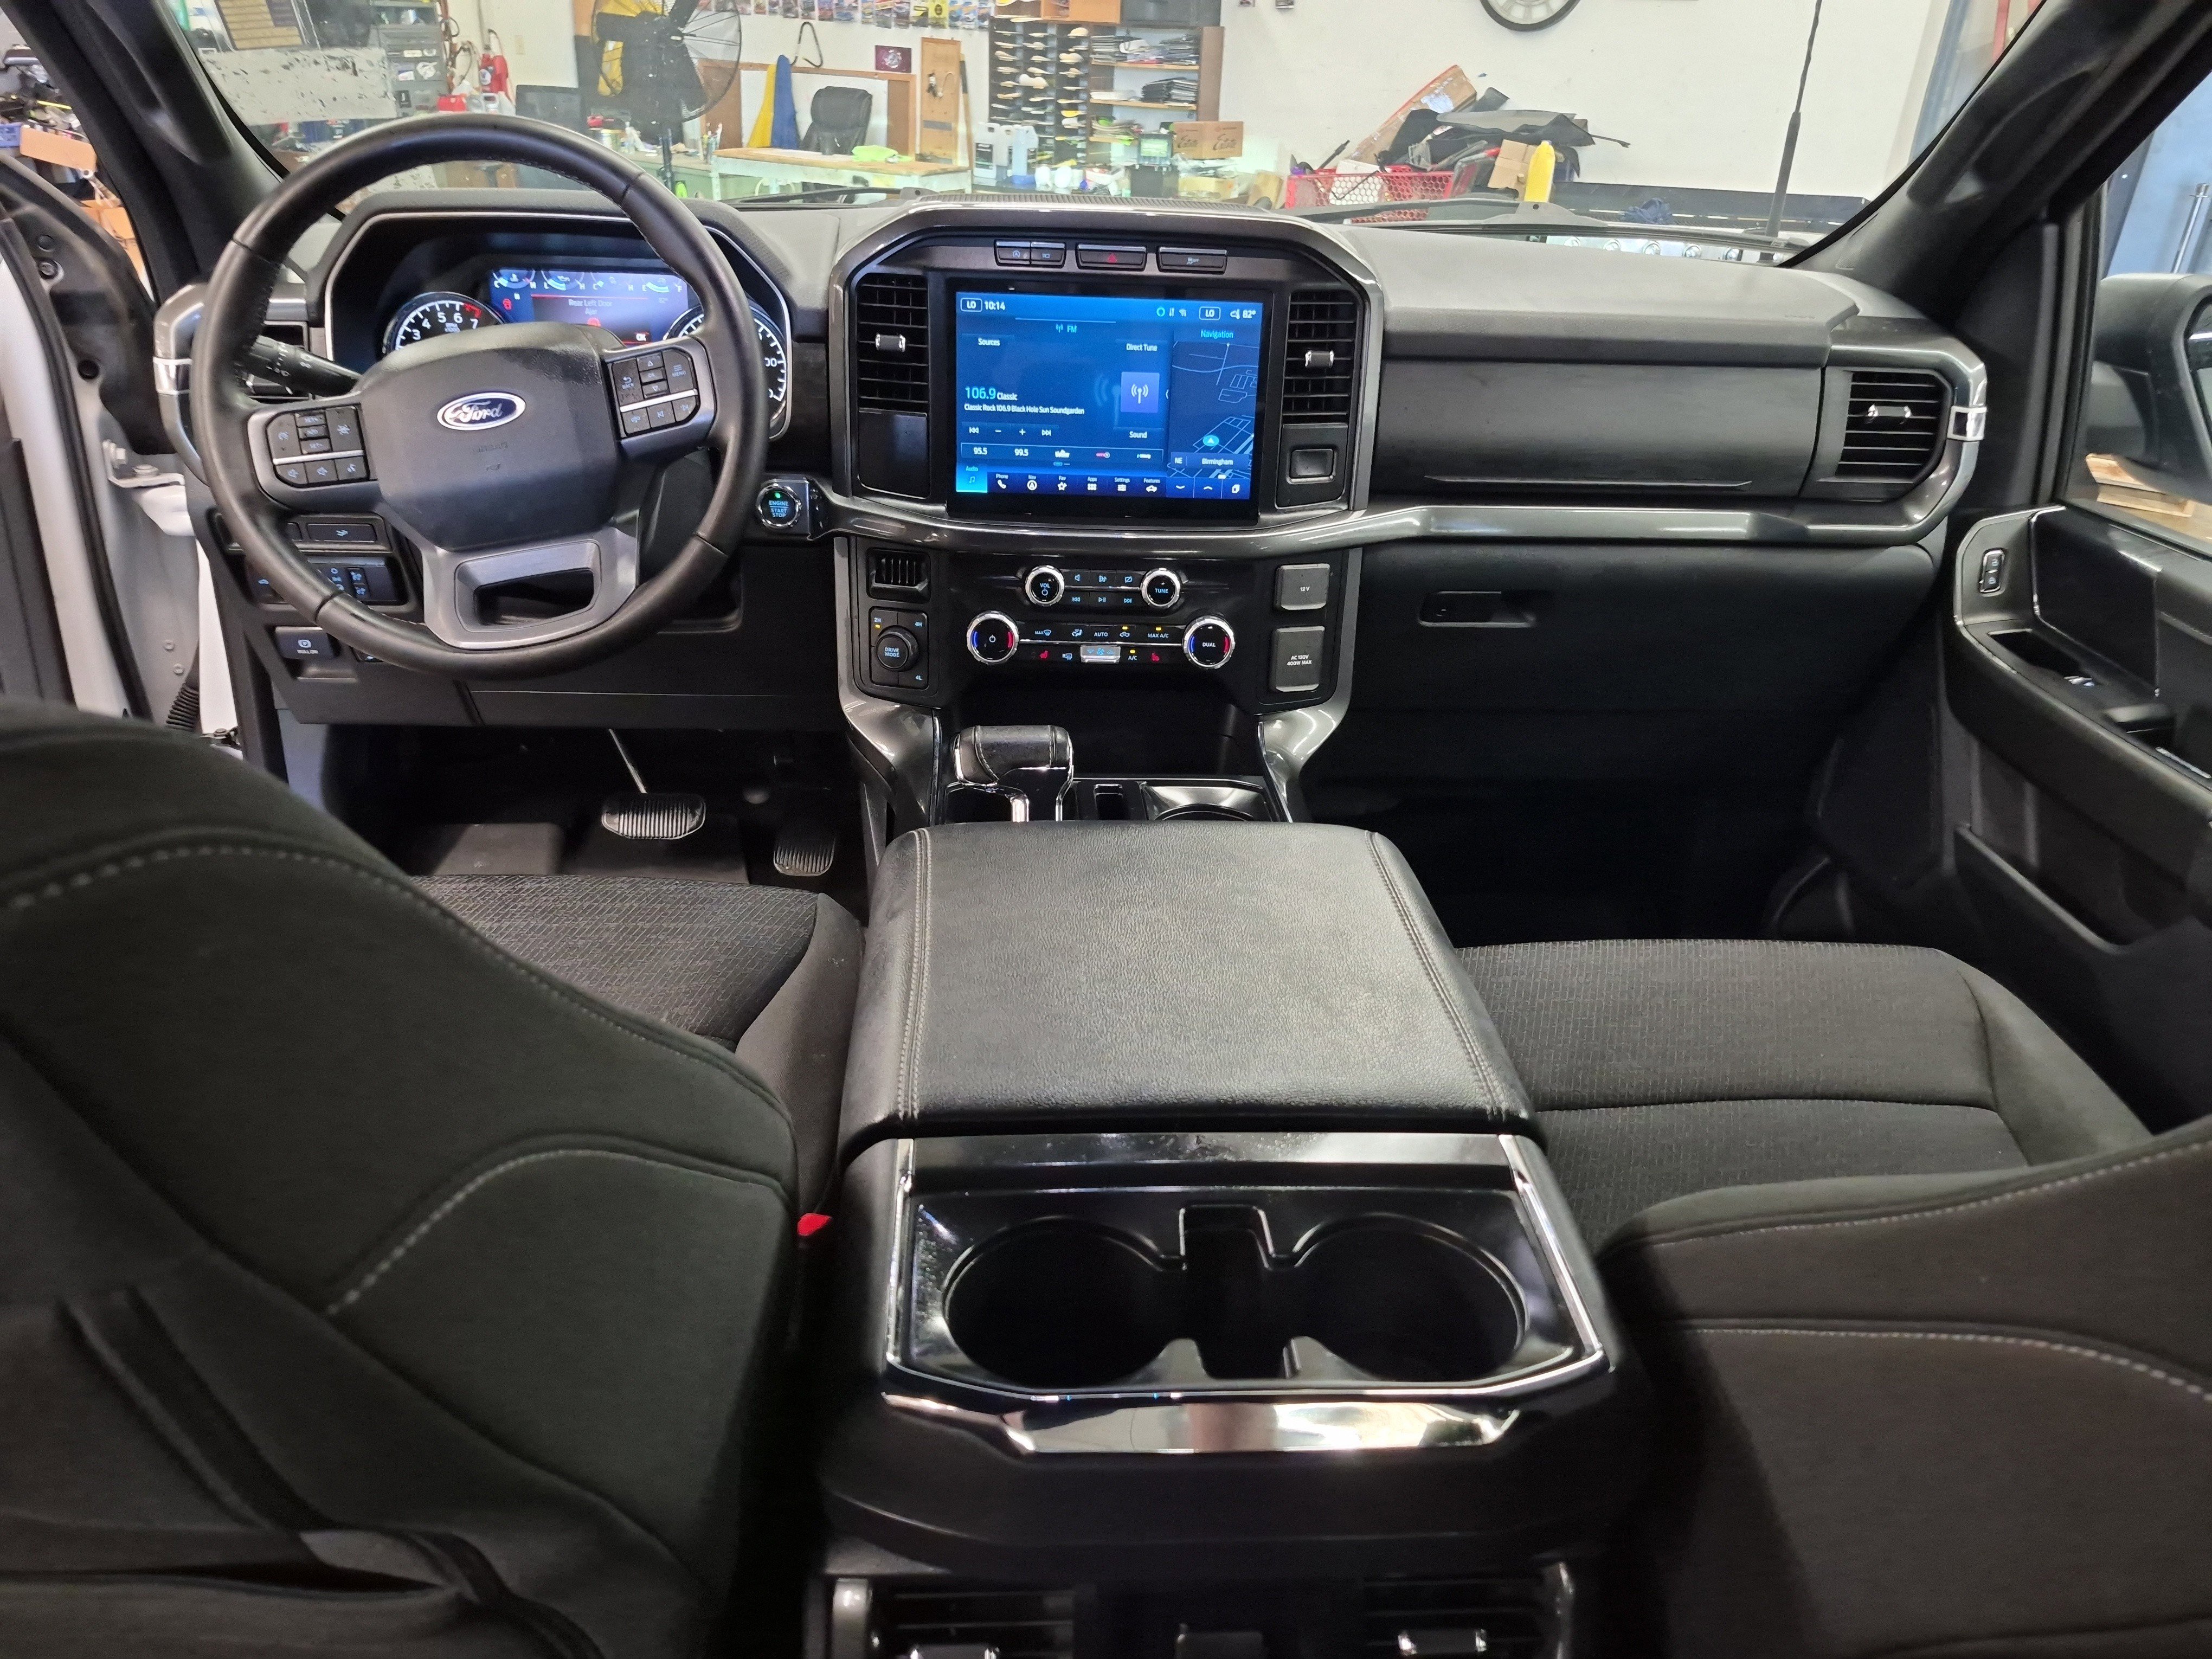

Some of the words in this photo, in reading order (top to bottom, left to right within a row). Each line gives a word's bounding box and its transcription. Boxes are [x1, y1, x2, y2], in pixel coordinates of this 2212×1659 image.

[985, 301, 1005, 311] 10:14
[437, 312, 447, 323] 5
[453, 312, 463, 323] 6
[1242, 309, 1256, 319] 82°
[422, 318, 432, 329] 4
[470, 318, 478, 329] 7
[1067, 324, 1077, 333] FM
[412, 329, 421, 340] 3
[1200, 329, 1233, 339] Navigation
[978, 338, 1000, 346] Sources
[1126, 343, 1142, 351] Direct
[965, 386, 996, 399] 106.9
[997, 392, 1018, 401] Classic
[449, 401, 503, 422] Ford
[1050, 407, 1085, 415] Soundgarden
[1129, 430, 1148, 439] Sound
[973, 447, 988, 455] 95.5
[1014, 448, 1029, 456] 99.5
[1201, 458, 1233, 466] Birmingham
